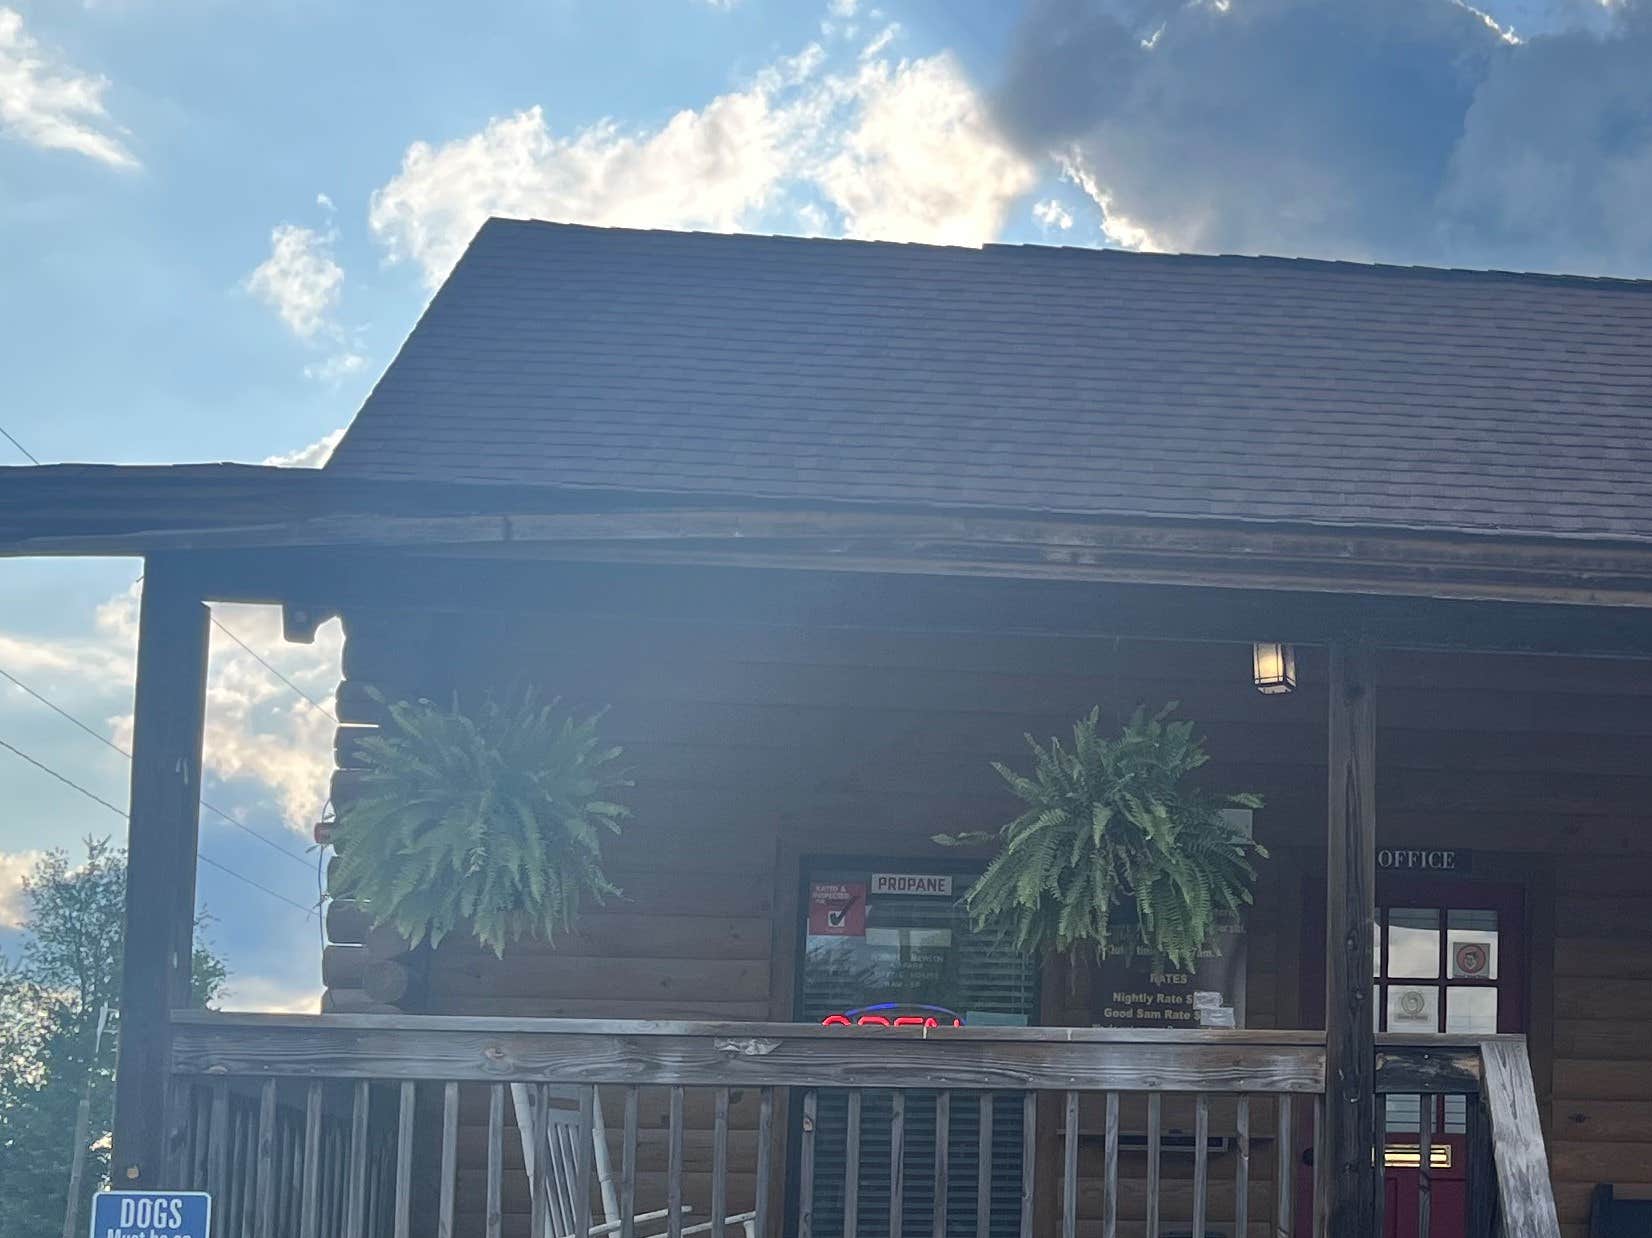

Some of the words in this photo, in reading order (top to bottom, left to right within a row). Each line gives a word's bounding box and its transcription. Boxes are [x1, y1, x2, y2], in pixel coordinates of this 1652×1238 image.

[1378, 850, 1456, 869] OFFICE
[878, 876, 945, 892] PROPANE
[1150, 973, 1188, 985] RATES
[1112, 991, 1152, 1005] Nightly
[1156, 993, 1183, 1004] Rate
[1104, 1007, 1133, 1018] Good
[1136, 1008, 1161, 1019] Sam
[1164, 1009, 1191, 1020] Rate
[120, 1198, 183, 1229] DOGS
